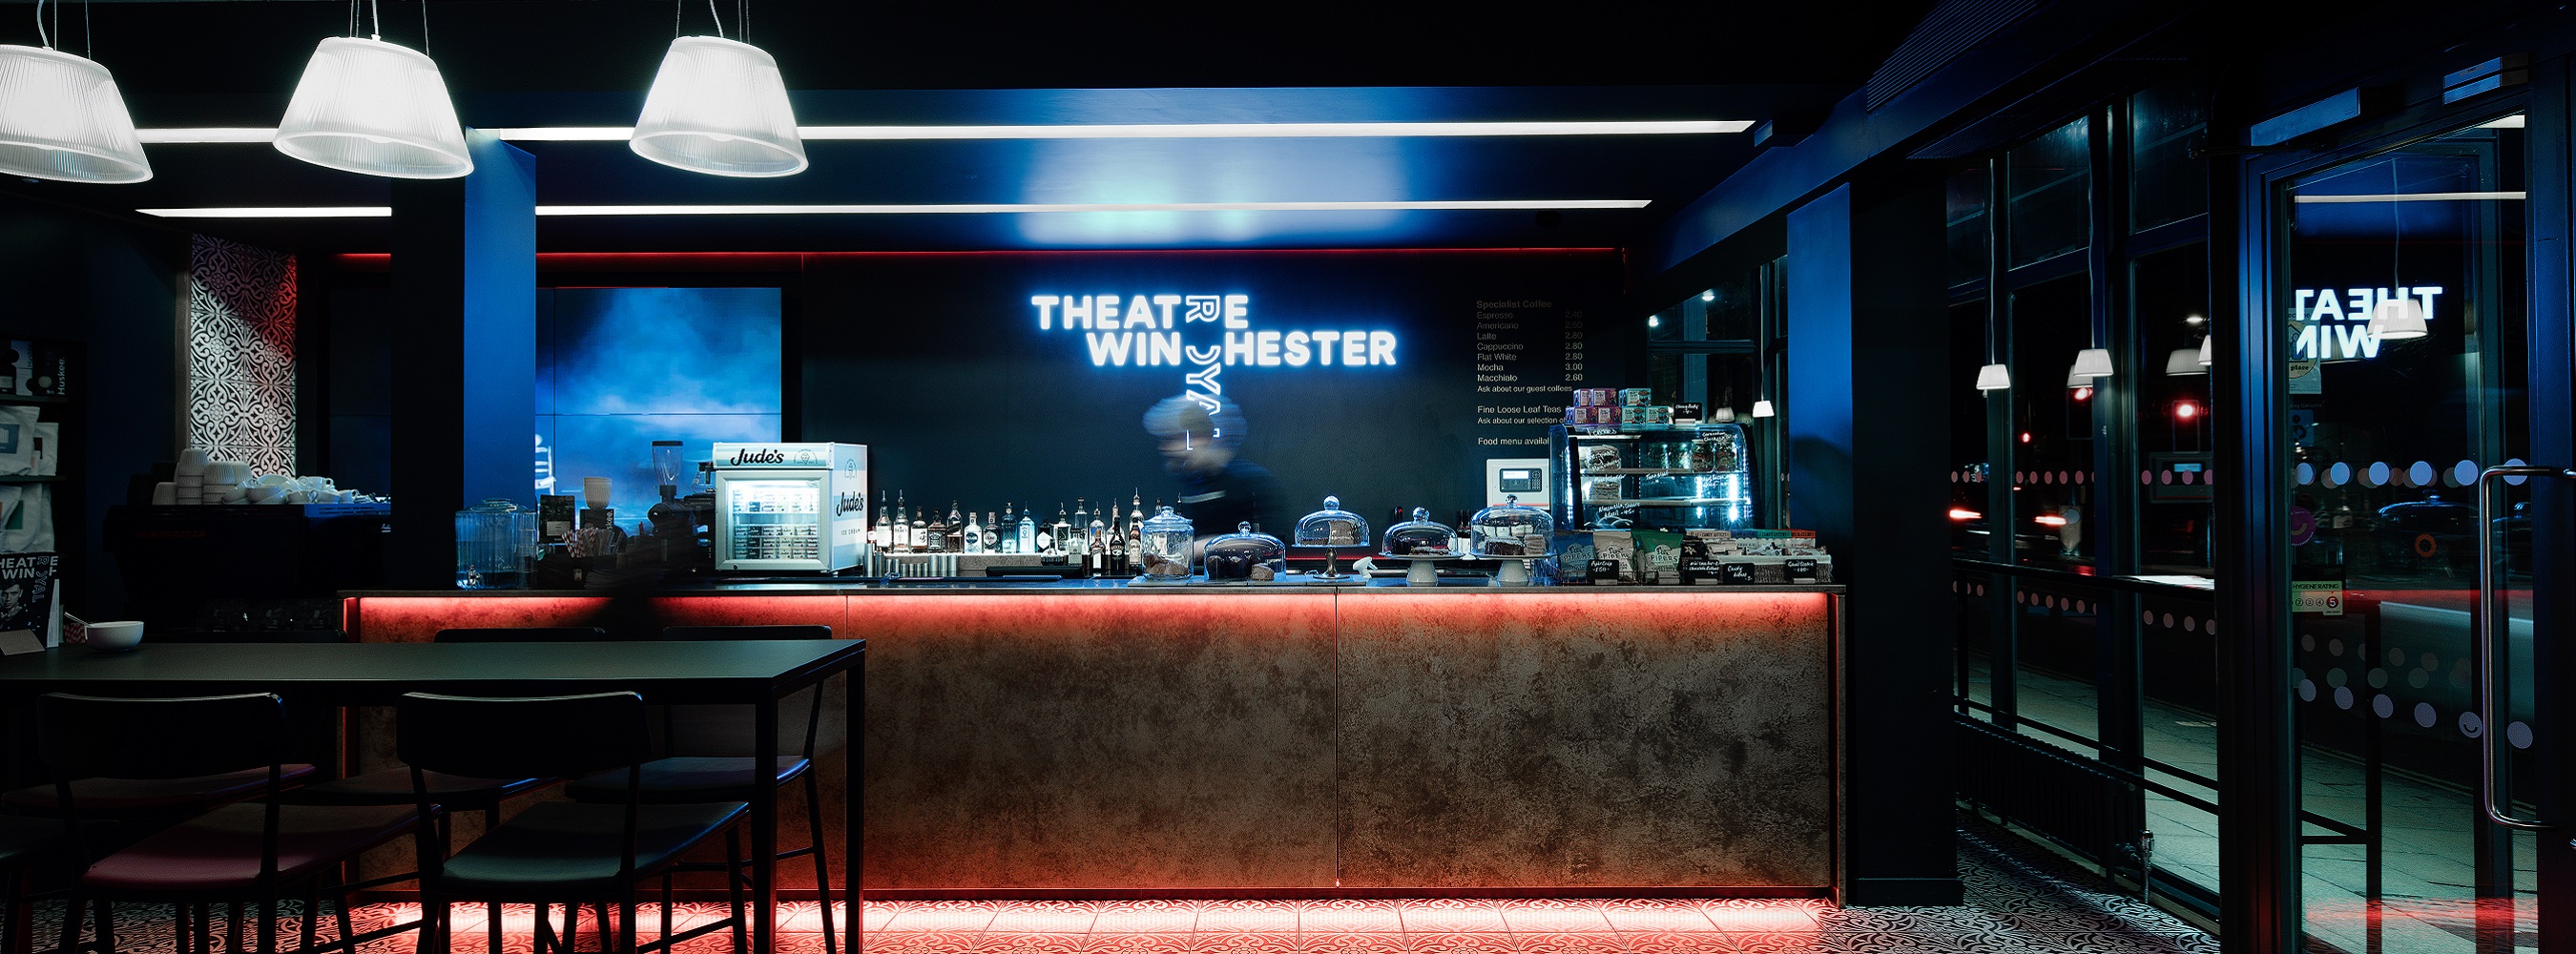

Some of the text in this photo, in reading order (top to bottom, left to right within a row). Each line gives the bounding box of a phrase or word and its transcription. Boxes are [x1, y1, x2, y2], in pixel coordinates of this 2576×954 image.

[1476, 300, 1552, 309] Specialist Coffee
[1477, 311, 1513, 320] Espresso
[1477, 342, 1524, 351] Cappuccino
[1527, 385, 1547, 394] guest
[730, 448, 784, 467] Jude's
[836, 491, 864, 517] Jude's
[1563, 551, 1591, 562] PIPERS
[2329, 597, 2337, 607] 5
